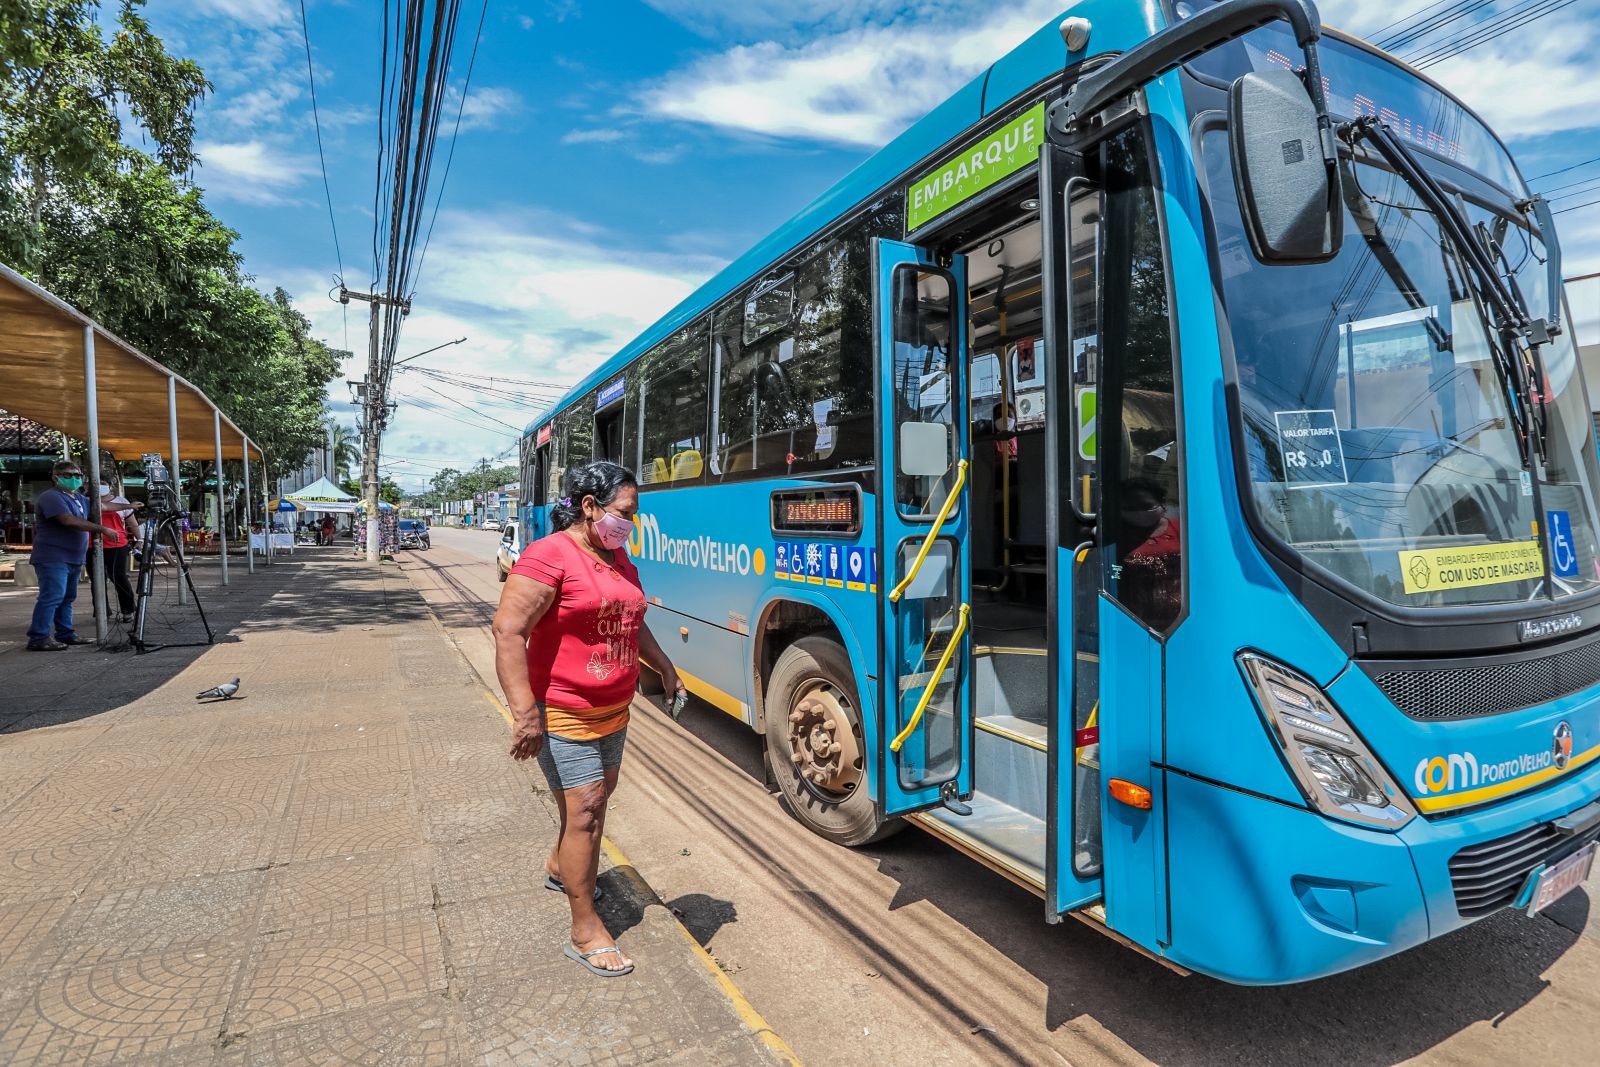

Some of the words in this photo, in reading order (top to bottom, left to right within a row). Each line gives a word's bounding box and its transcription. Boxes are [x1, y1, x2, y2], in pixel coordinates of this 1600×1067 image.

[914, 117, 1035, 210] EMBARQUE
[913, 142, 1035, 220] BOARDING
[1283, 429, 1309, 437] VALOR
[1309, 428, 1334, 436] TARIFA
[1285, 450, 1307, 468] R$
[1436, 553, 1477, 566] EMBARQUE
[1476, 550, 1509, 562] PERMITIDO
[1511, 547, 1537, 559] SOMENTE
[1439, 569, 1463, 583] COM
[1465, 566, 1485, 581] USO
[1488, 564, 1500, 578] DE
[1501, 560, 1541, 576] MÁSCARA
